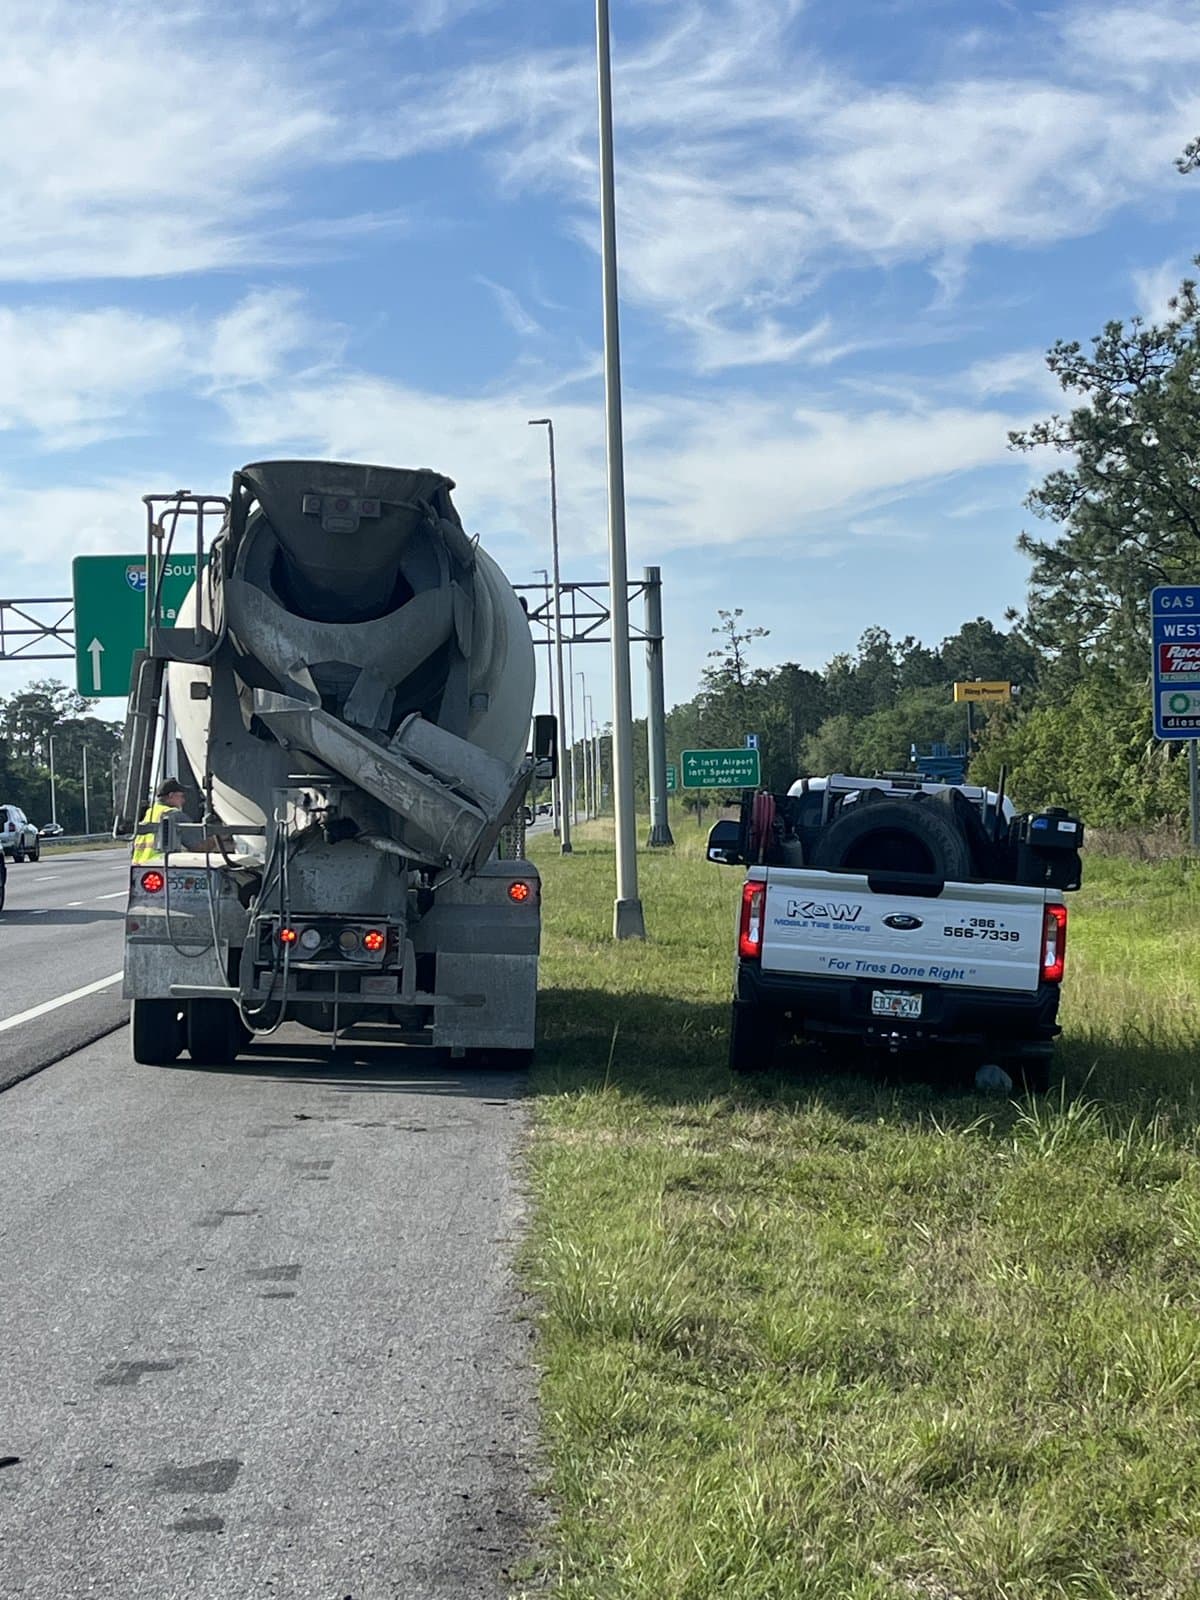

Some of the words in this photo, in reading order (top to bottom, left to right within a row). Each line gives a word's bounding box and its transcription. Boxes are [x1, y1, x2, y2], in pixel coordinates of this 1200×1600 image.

[129, 572, 147, 586] 95
[1161, 596, 1194, 608] GAS
[747, 735, 757, 748] H
[722, 758, 753, 767] Airport
[709, 768, 752, 776] Speedway
[786, 900, 862, 921] K&W
[774, 918, 808, 928] MOBILE
[811, 921, 831, 929] TIRE
[833, 923, 871, 932] SERVICE
[969, 918, 995, 928] 386
[943, 926, 1020, 942] 566-7339
[828, 958, 852, 970] For
[855, 960, 886, 974] Tires
[890, 963, 925, 977] Done
[928, 966, 965, 981] Right
